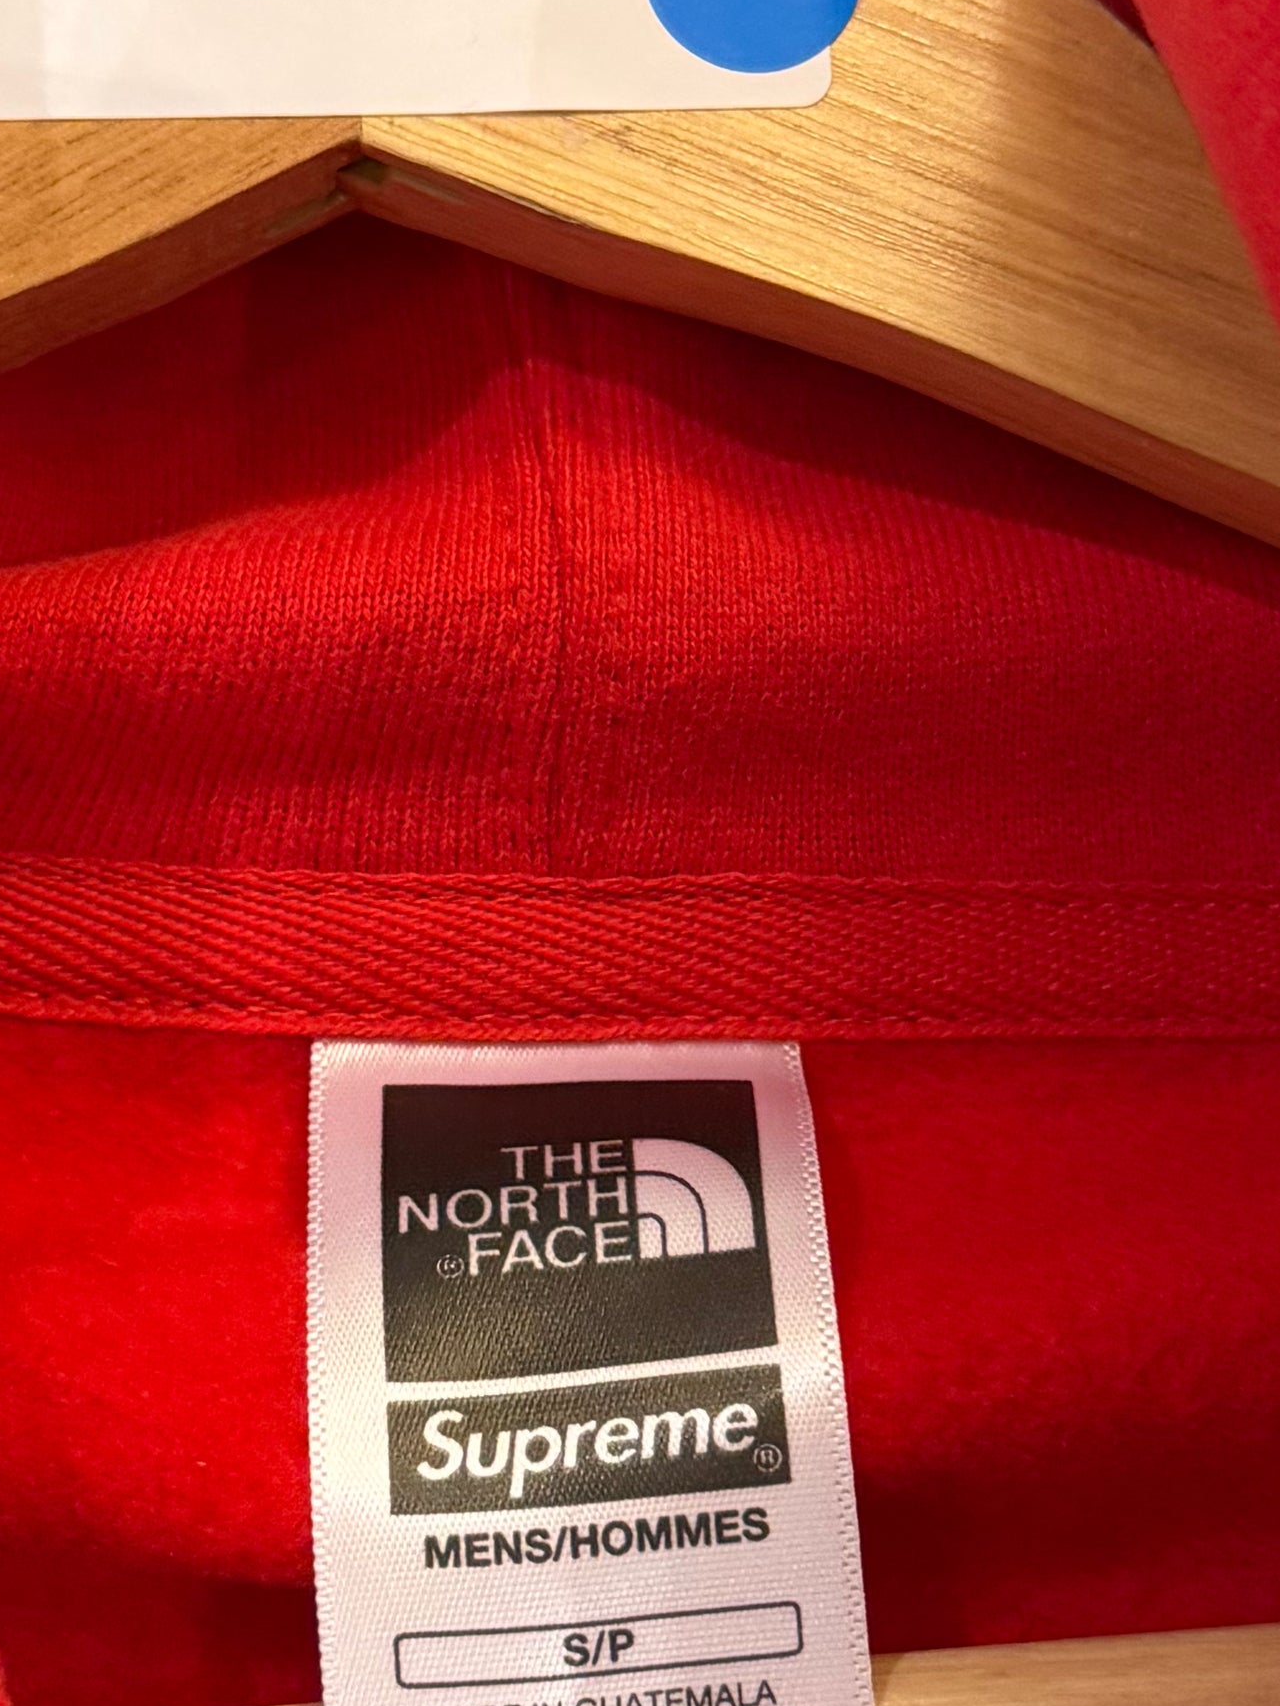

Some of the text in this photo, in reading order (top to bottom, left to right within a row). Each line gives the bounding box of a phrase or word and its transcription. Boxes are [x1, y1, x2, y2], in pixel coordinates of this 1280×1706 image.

[500, 1139, 627, 1180] THE
[398, 1176, 628, 1233] NORTH
[468, 1220, 632, 1276] FACE
[417, 1403, 759, 1499] Supreme
[424, 1507, 770, 1569] MENS/HOMMES
[563, 1628, 635, 1667] S/P
